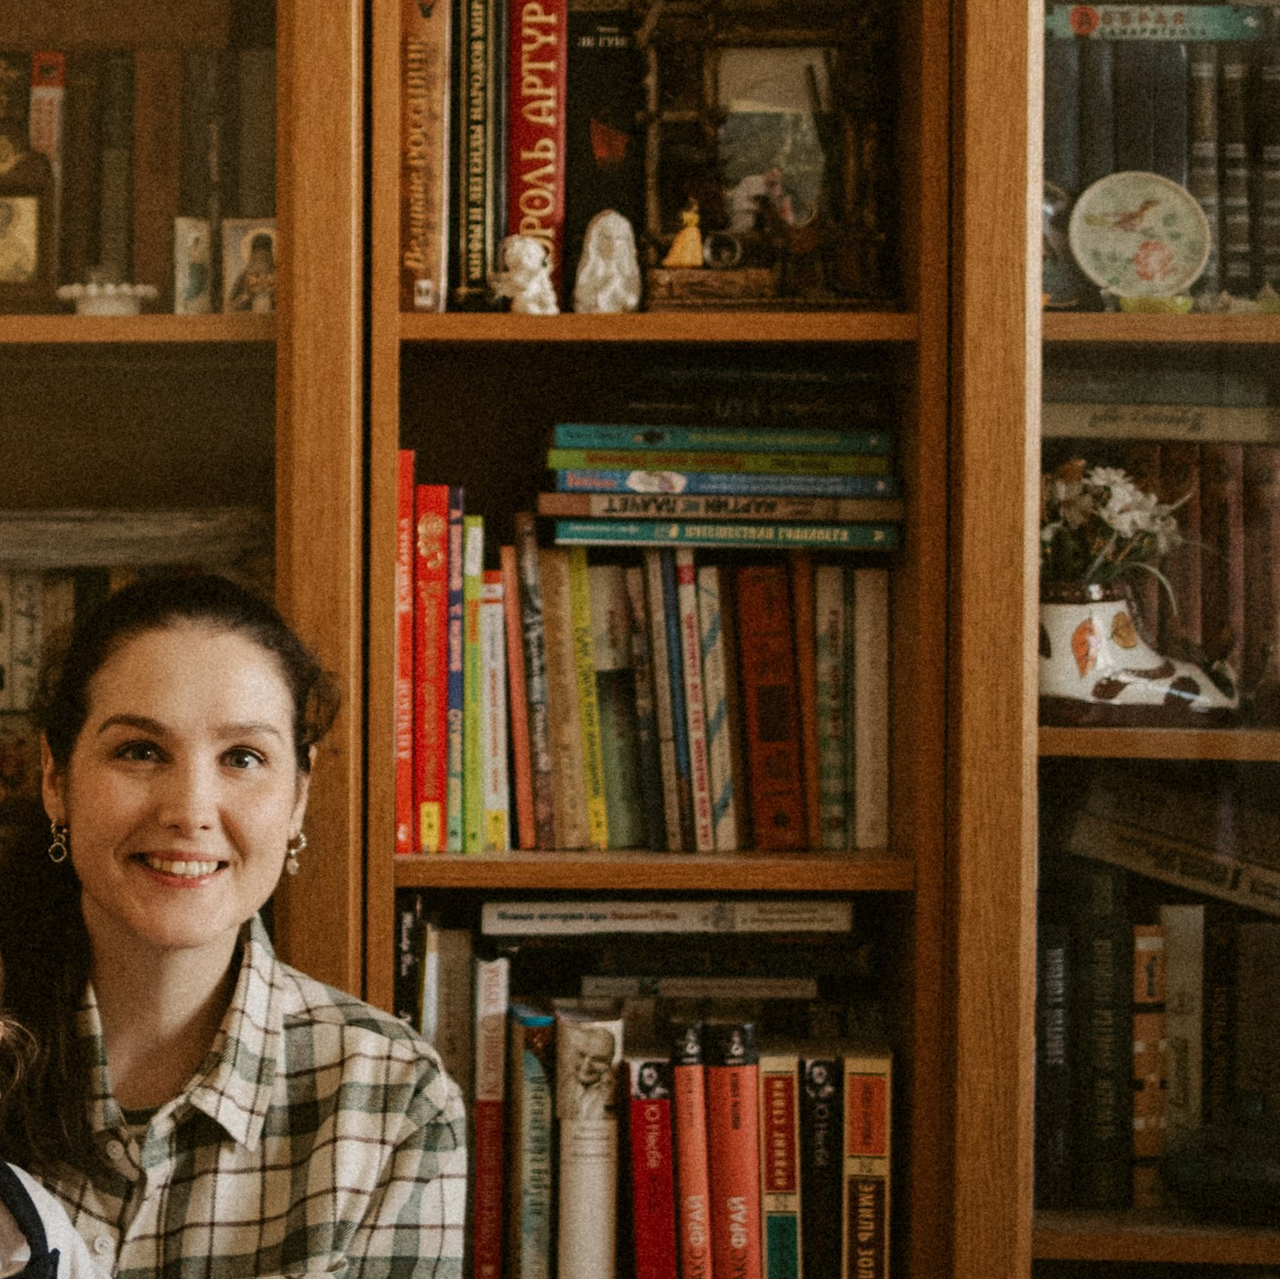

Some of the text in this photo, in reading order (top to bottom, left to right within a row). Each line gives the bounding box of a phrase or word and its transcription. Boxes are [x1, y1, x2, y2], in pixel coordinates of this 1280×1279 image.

[469, 40, 484, 121] НАРОДОВ
[518, 1, 558, 255] РОЛЬ АРТУР
[469, 124, 484, 204] ЛЕГЕНДЫ
[469, 207, 484, 221] И
[469, 223, 484, 280] МИФЫ
[604, 497, 677, 514] ПЛАЧЕТ
[704, 497, 777, 514] МАРТИН
[645, 1103, 662, 1121] Ю
[813, 1102, 829, 1121] Ю
[684, 1194, 705, 1249] ФРАЙ
[728, 1195, 747, 1249] ФРАЙ
[857, 1183, 876, 1243] ЭМИЛЬ
